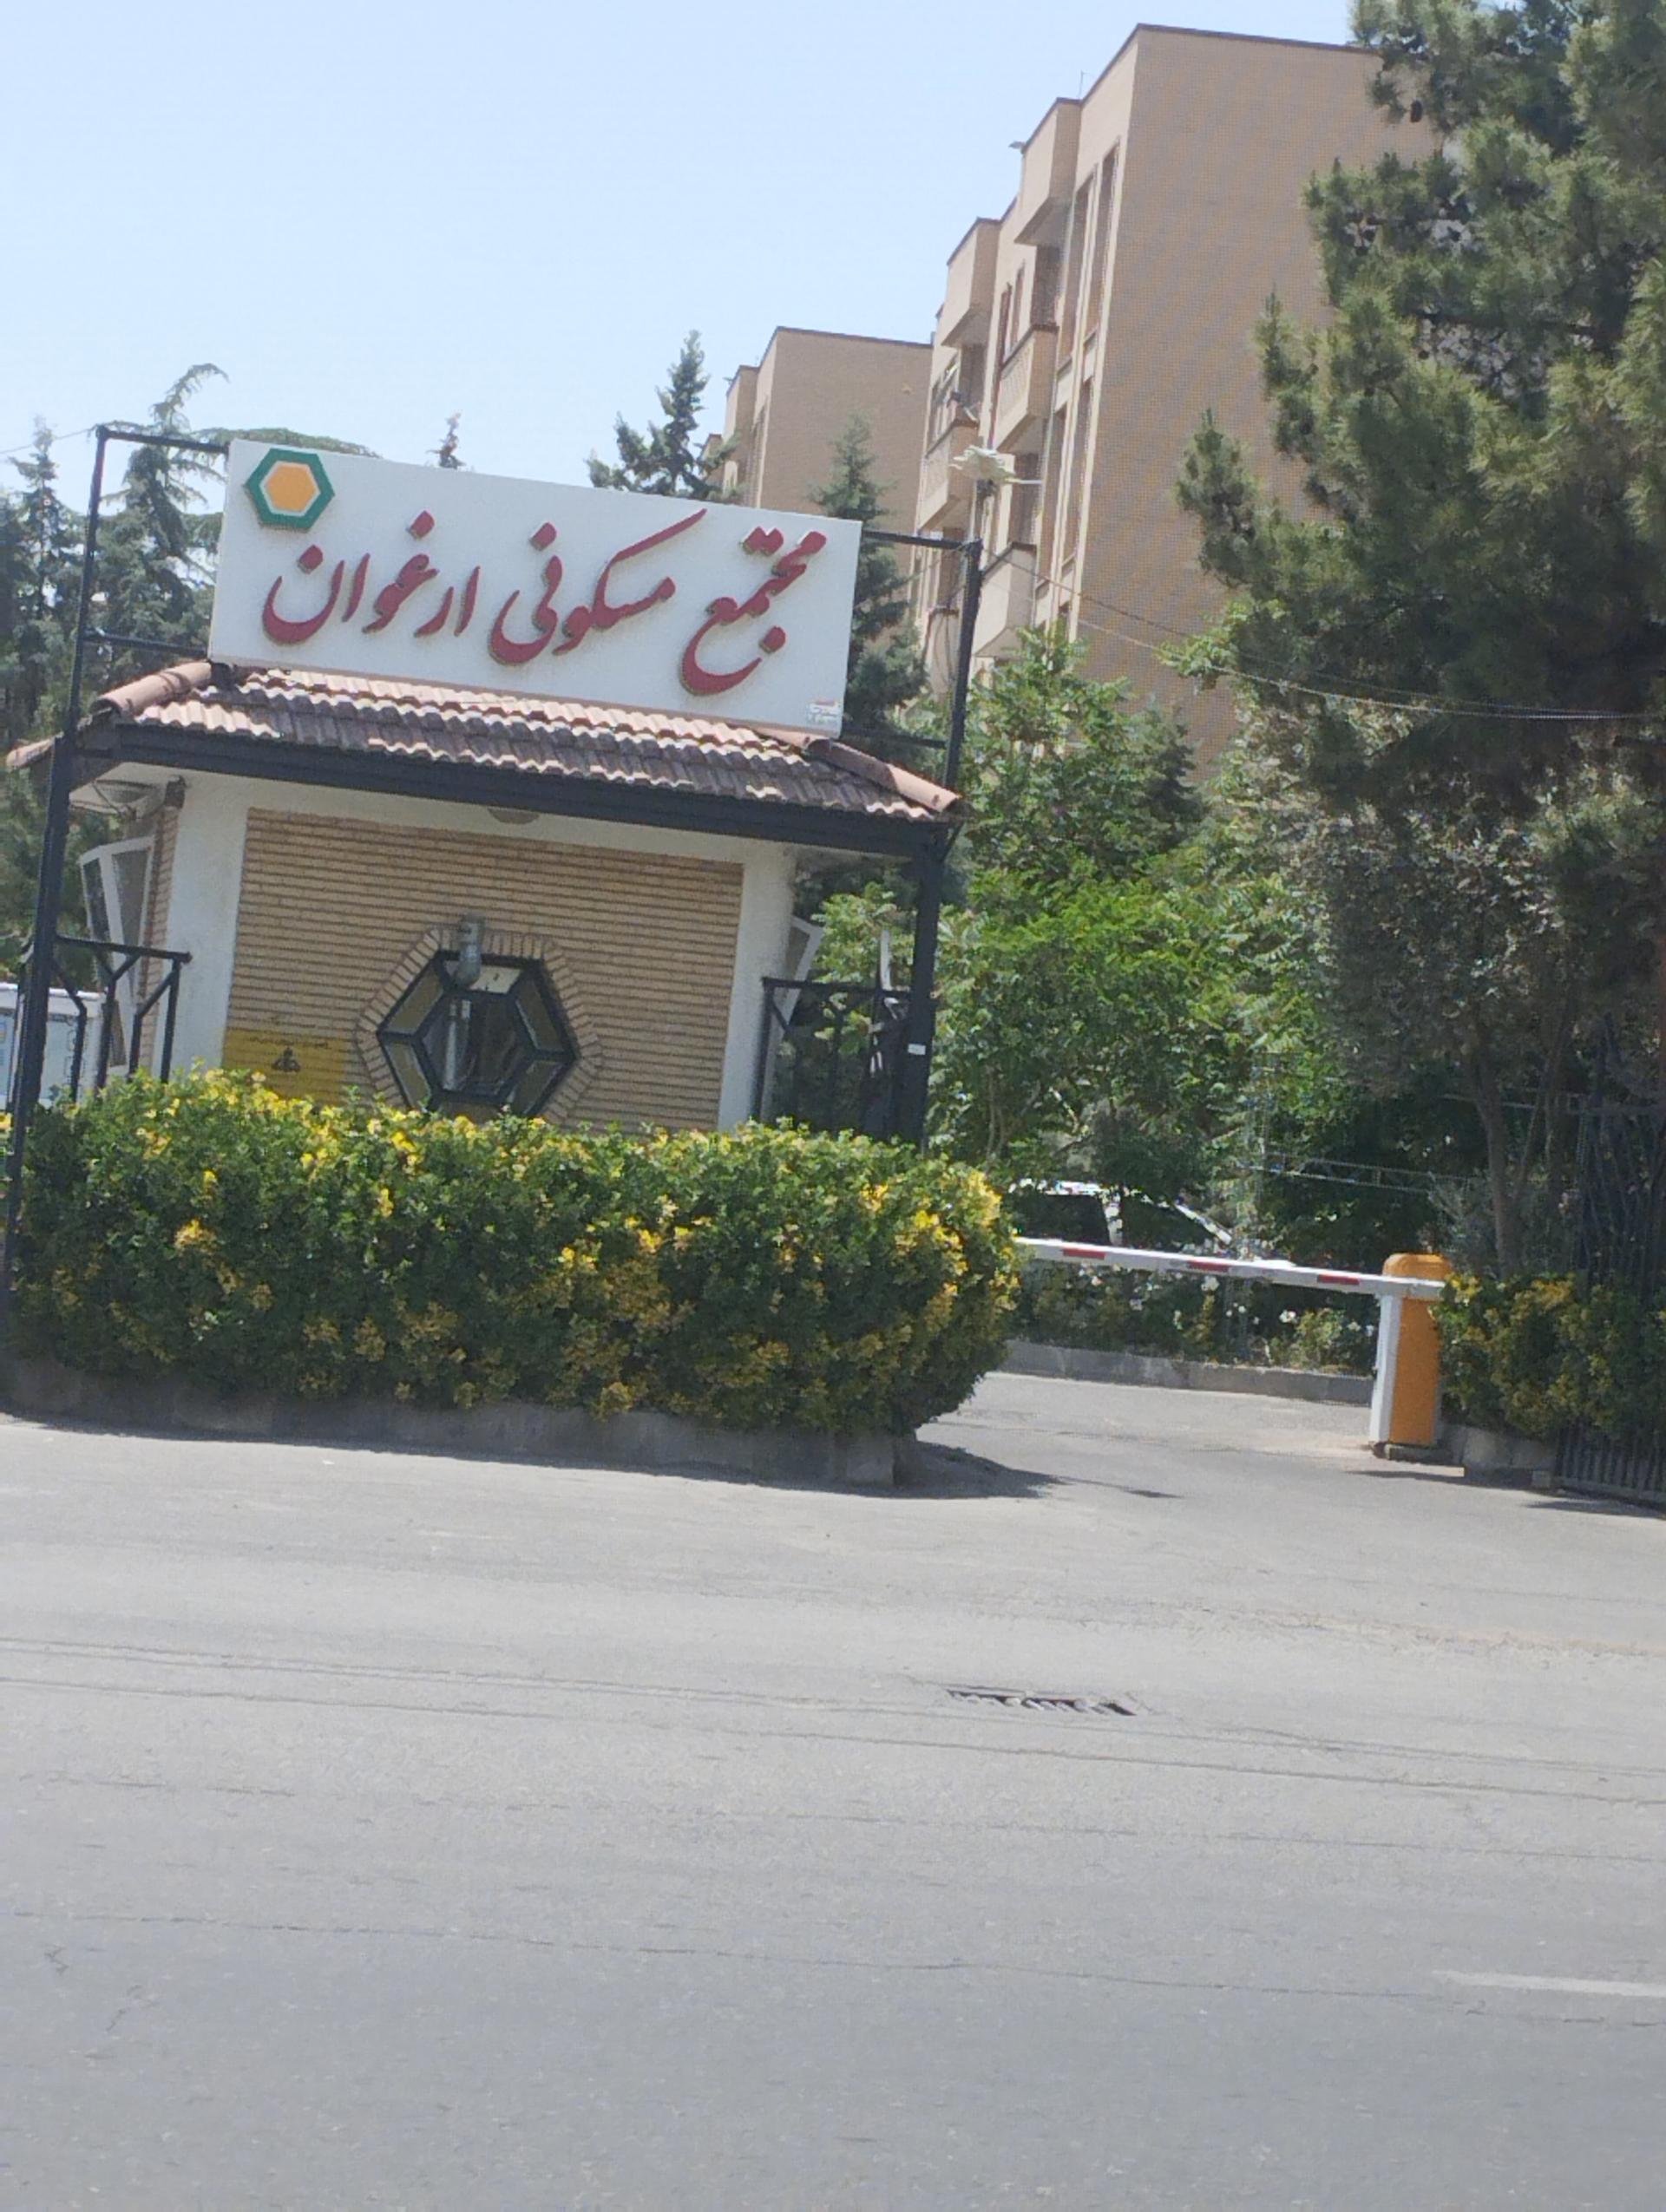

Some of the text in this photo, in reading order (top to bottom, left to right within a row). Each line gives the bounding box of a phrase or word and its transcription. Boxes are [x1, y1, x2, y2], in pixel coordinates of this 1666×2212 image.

[261, 508, 828, 695] مجتمع مسکونی ارغوان
